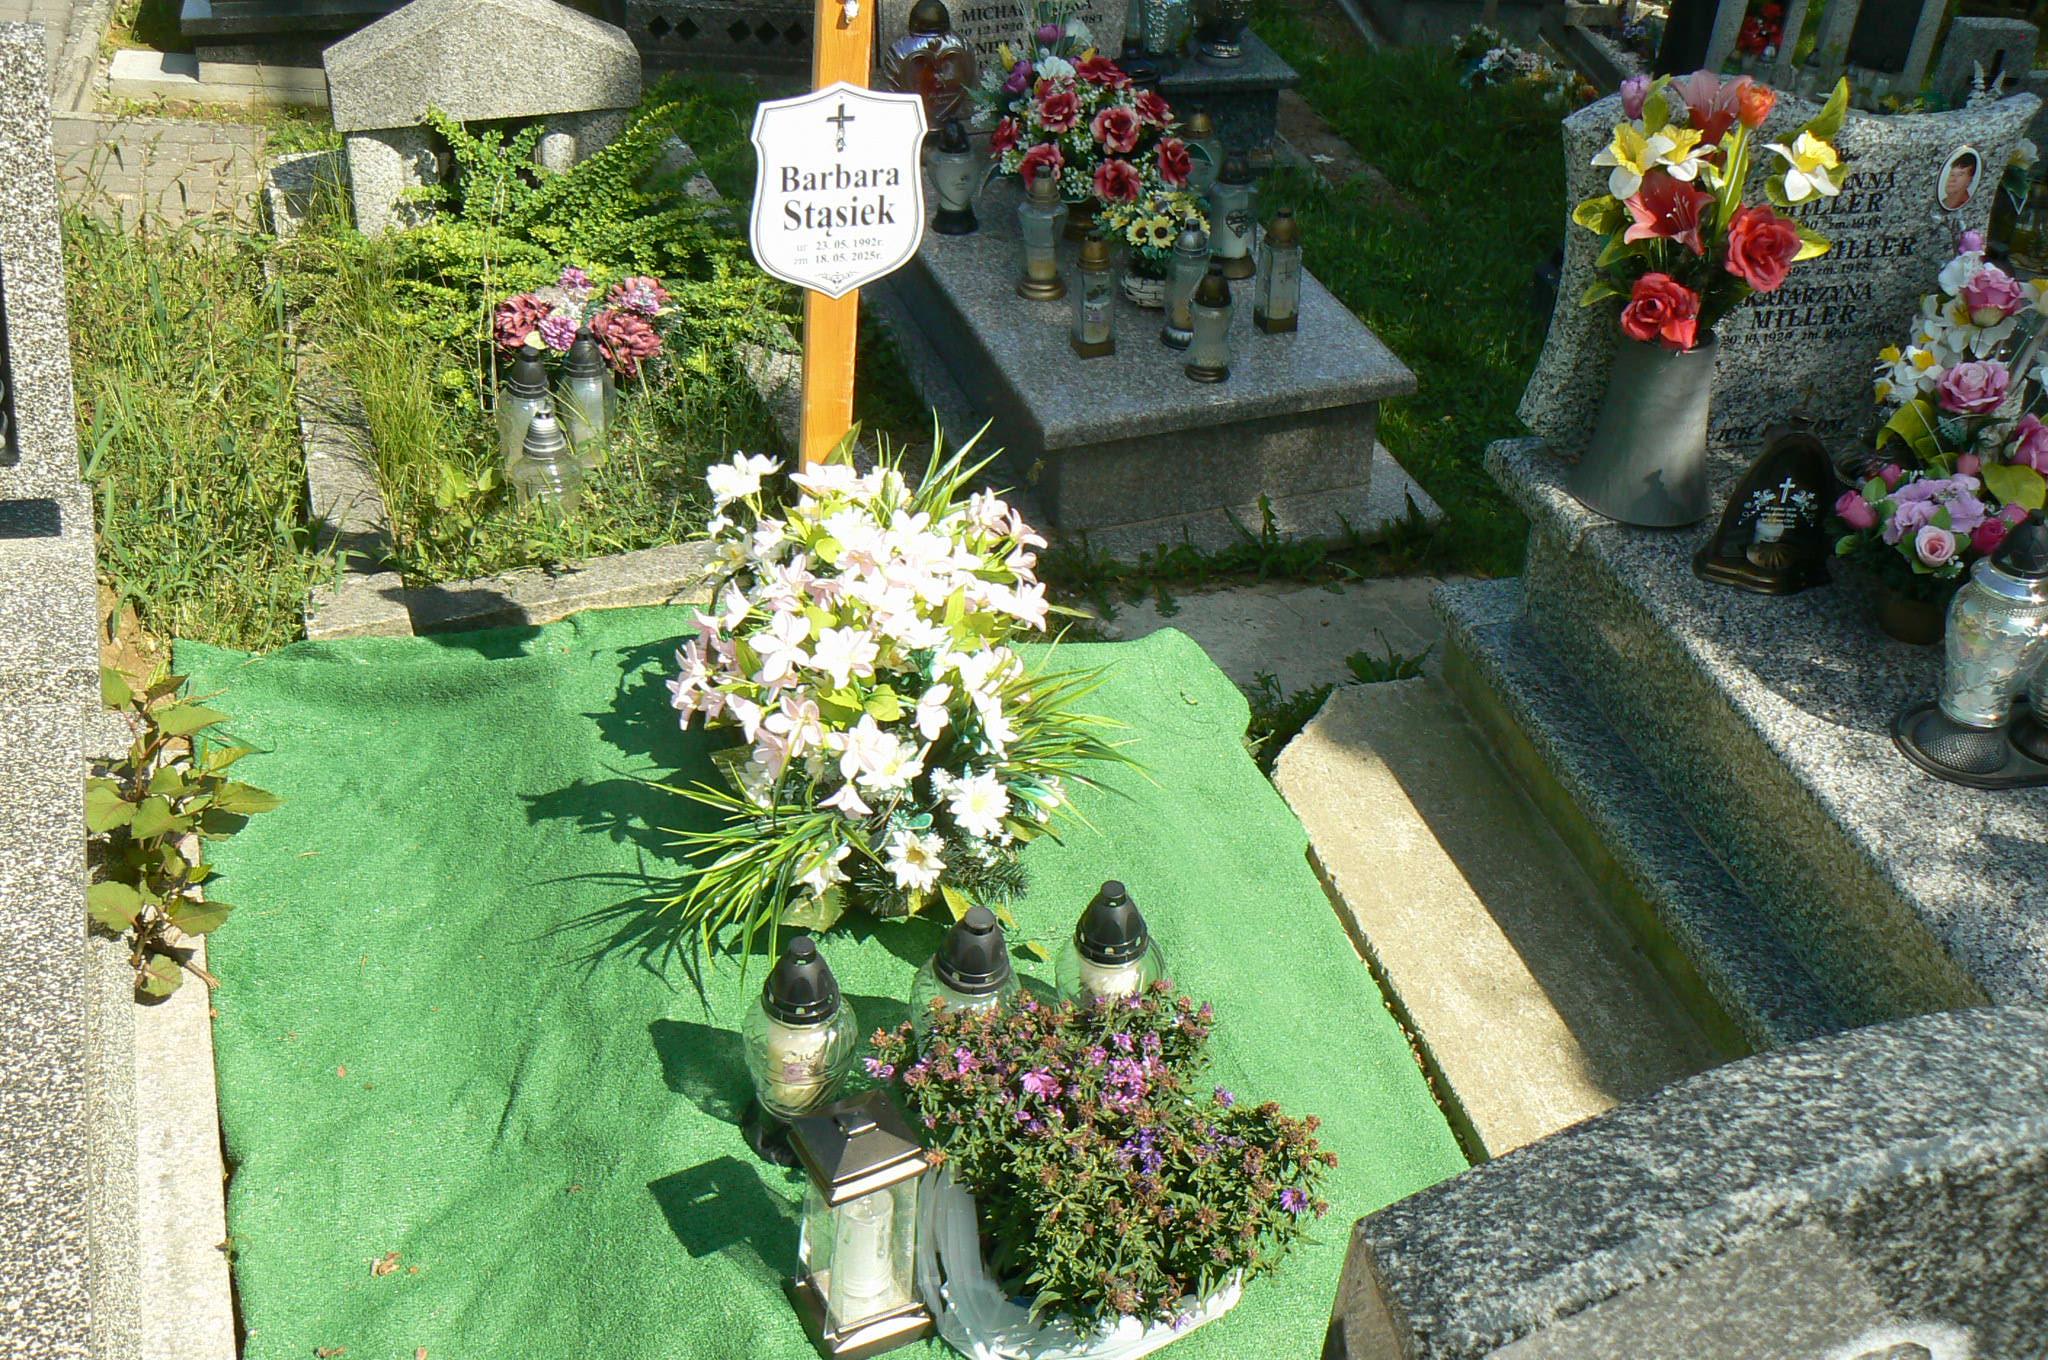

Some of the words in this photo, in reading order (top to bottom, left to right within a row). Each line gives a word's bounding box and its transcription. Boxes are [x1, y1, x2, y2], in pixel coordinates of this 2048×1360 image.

[780, 163, 900, 193] Barbara
[783, 194, 897, 237] Stąsiek
[1824, 235, 1917, 260] ILLER
[1744, 282, 1873, 307] KATARZYNA
[1752, 304, 1857, 329] MILLER
